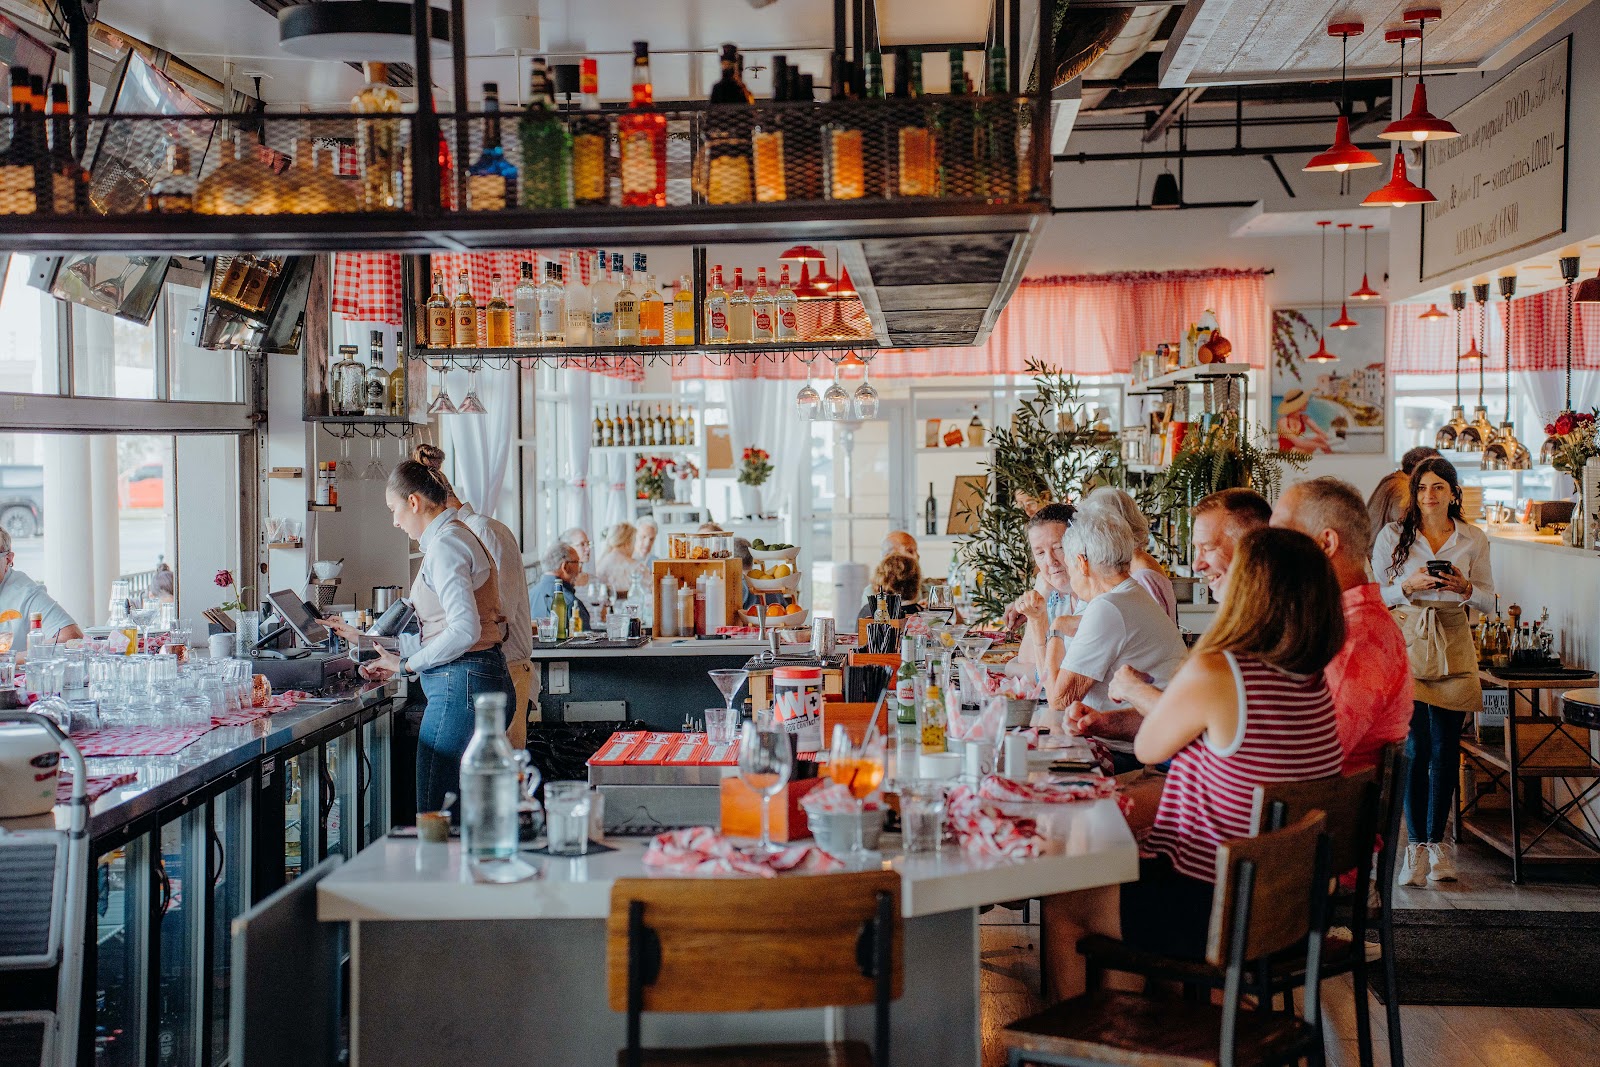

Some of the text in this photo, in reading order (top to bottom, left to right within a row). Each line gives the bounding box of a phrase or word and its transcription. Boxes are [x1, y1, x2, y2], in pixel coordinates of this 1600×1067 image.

[1505, 89, 1530, 127] FOOD
[1473, 173, 1482, 199] IT
[1492, 154, 1530, 191] sometimes
[1532, 131, 1555, 173] LOUDLY
[796, 719, 816, 730] CONTACT
